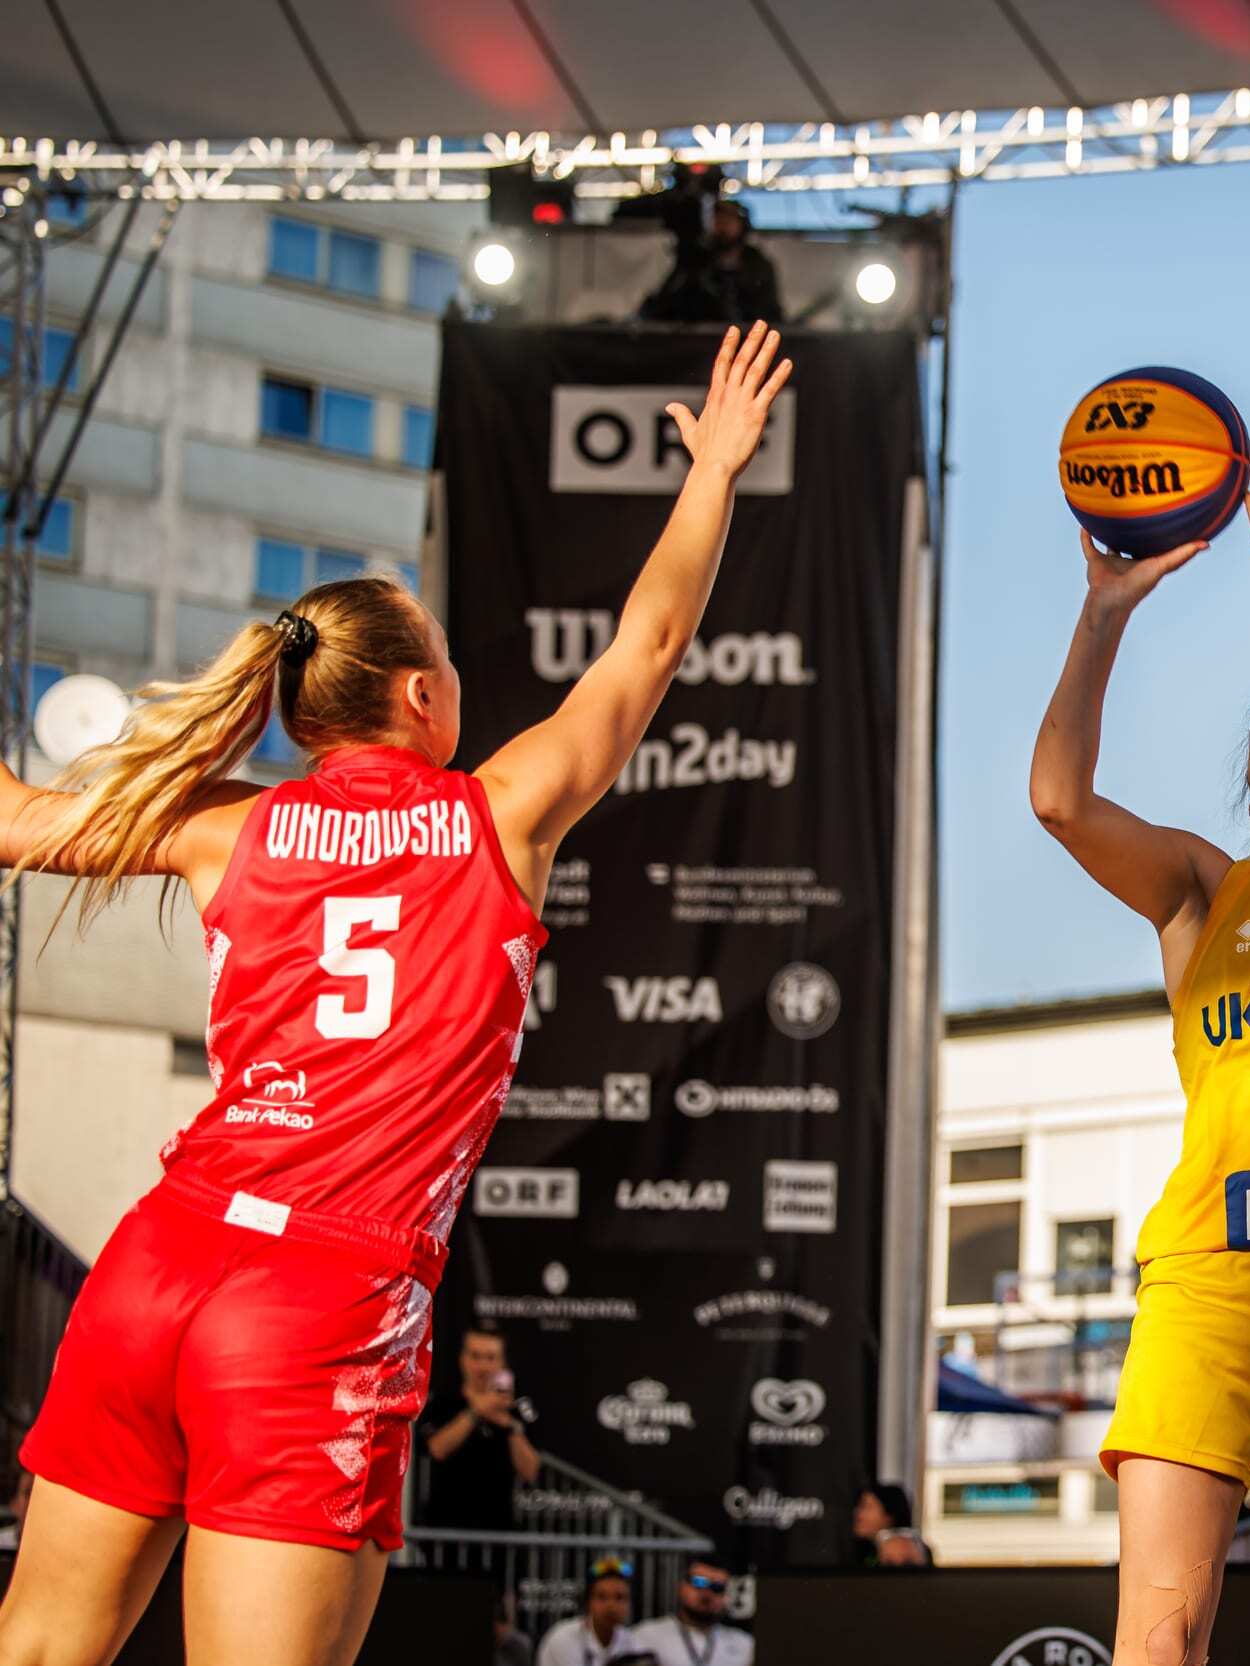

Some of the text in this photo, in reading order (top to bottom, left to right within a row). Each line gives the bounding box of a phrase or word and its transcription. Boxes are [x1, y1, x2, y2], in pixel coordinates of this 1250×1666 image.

[573, 411, 773, 467] OR
[1064, 460, 1184, 498] Wilson
[525, 607, 803, 685] Wson
[267, 799, 473, 867] WNOROWSKA
[314, 894, 403, 1040] 5
[603, 974, 724, 1023] VISA
[486, 1176, 566, 1206] ORF
[723, 1485, 824, 1529] Culligan
